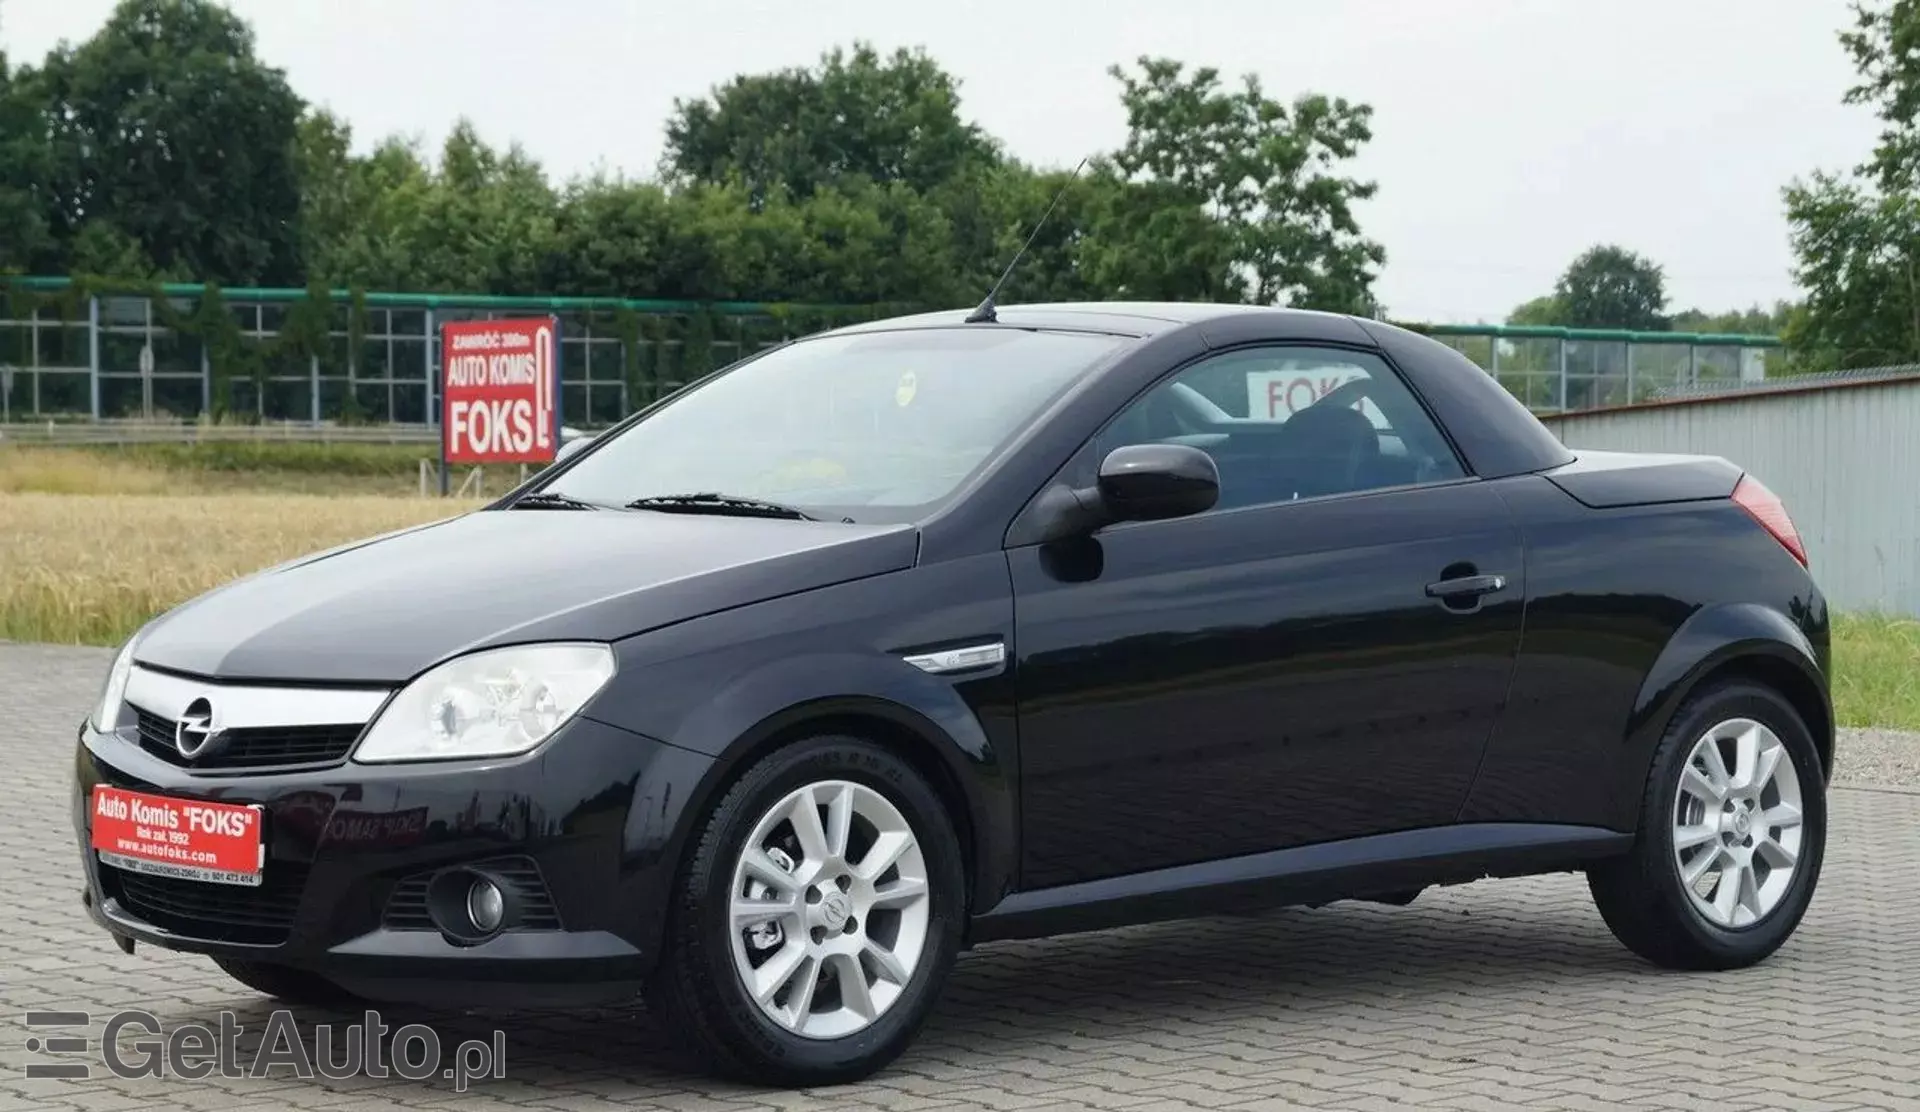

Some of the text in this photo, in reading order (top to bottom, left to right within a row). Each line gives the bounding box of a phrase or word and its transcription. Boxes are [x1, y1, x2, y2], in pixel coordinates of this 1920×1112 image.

[448, 353, 535, 387] AUTO KOMIS
[451, 398, 533, 454] FOKS
[97, 791, 252, 837] Auto Komis "FOKS"
[117, 838, 217, 864] www.autofoks.com
[169, 831, 189, 845] 1992
